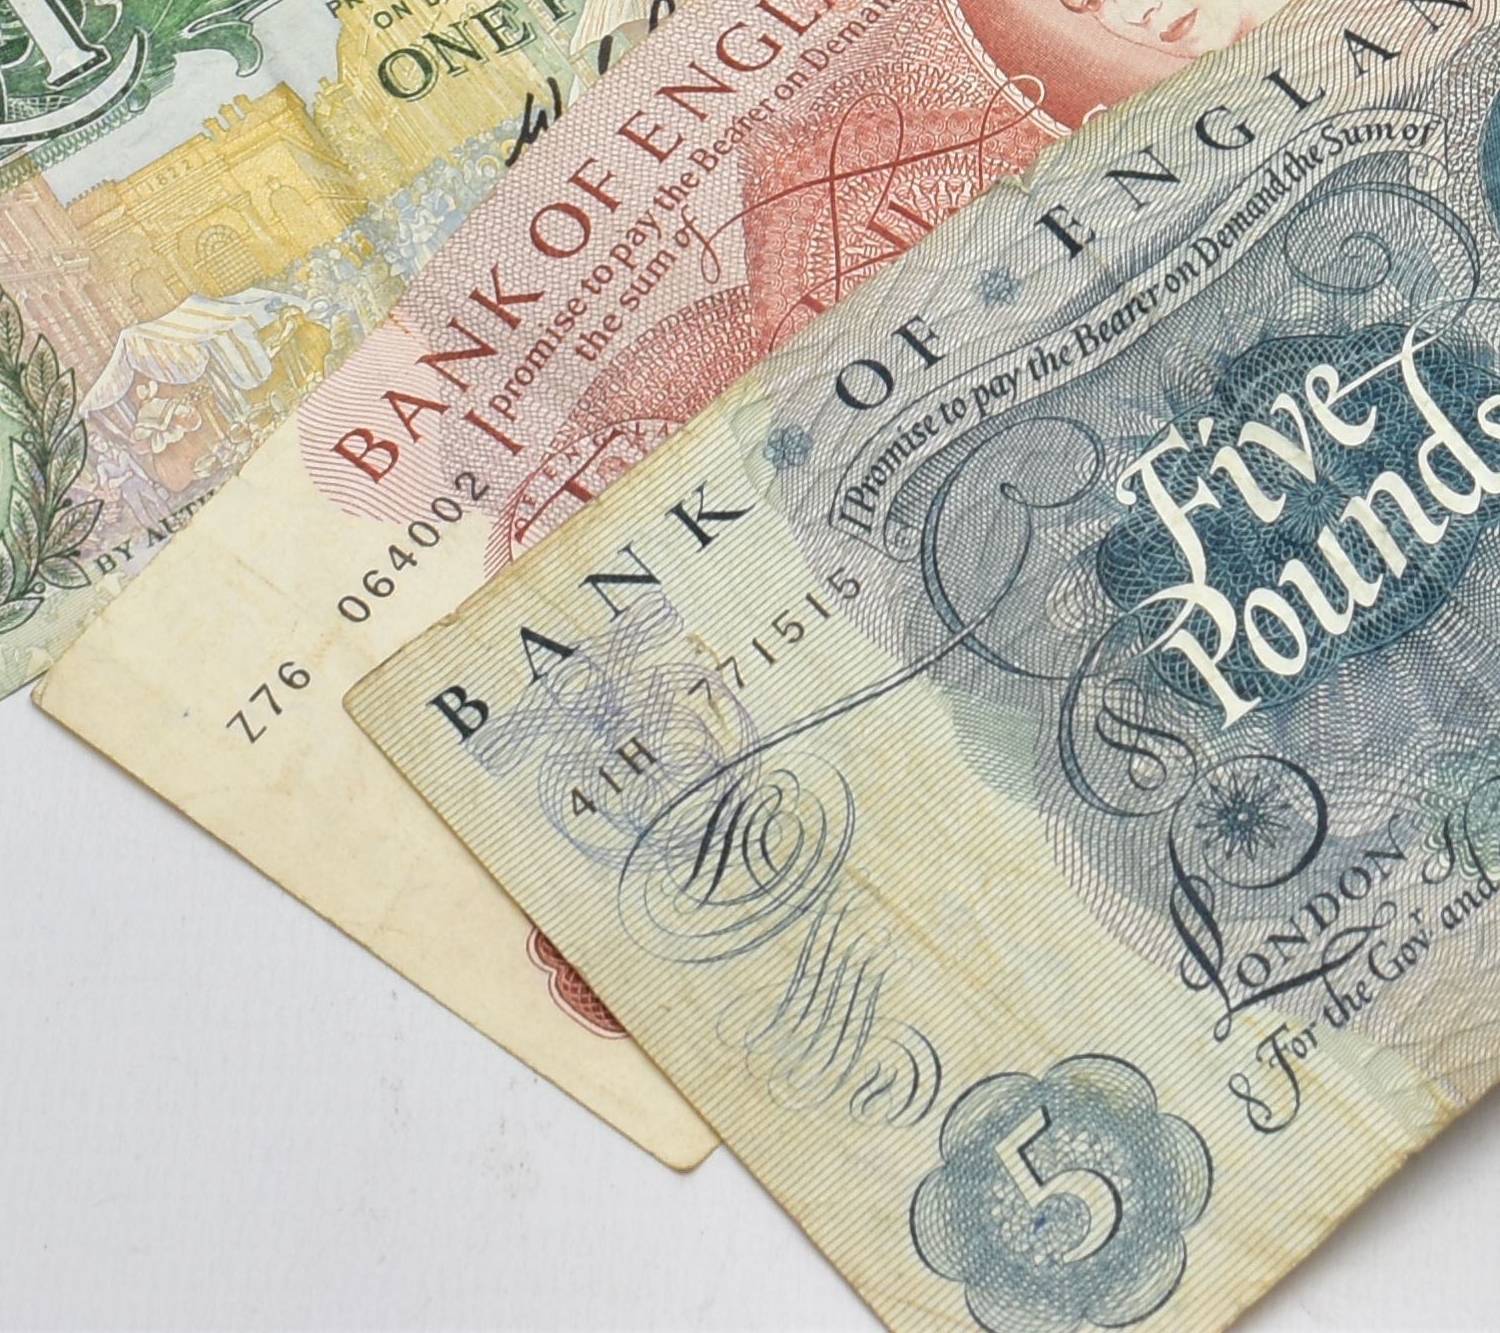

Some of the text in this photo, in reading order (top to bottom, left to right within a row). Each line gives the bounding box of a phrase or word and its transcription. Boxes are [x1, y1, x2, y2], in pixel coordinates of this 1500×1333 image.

[371, 0, 409, 33] ON
[377, 2, 535, 105] ONE
[330, 266, 543, 482] BANK
[530, 158, 622, 264] OF
[491, 290, 592, 429] promise
[583, 253, 616, 296] to
[607, 201, 663, 274] pay
[650, 160, 699, 220] the
[692, 94, 778, 176] Bearer
[772, 63, 806, 104] on
[577, 213, 714, 362] the sum of
[847, 115, 1438, 523] Promise to pay the Bearer on Demand the Sum of
[95, 545, 130, 579] BY
[426, 481, 757, 744] BANK
[835, 314, 948, 415] OF
[1113, 361, 1380, 588] Five
[227, 467, 491, 747] Z76 064002
[1168, 783, 1408, 1041] LONDON
[1230, 1025, 1322, 1135] For
[1317, 975, 1373, 1038] the
[1442, 879, 1500, 935] and
[994, 1105, 1124, 1267] 5
